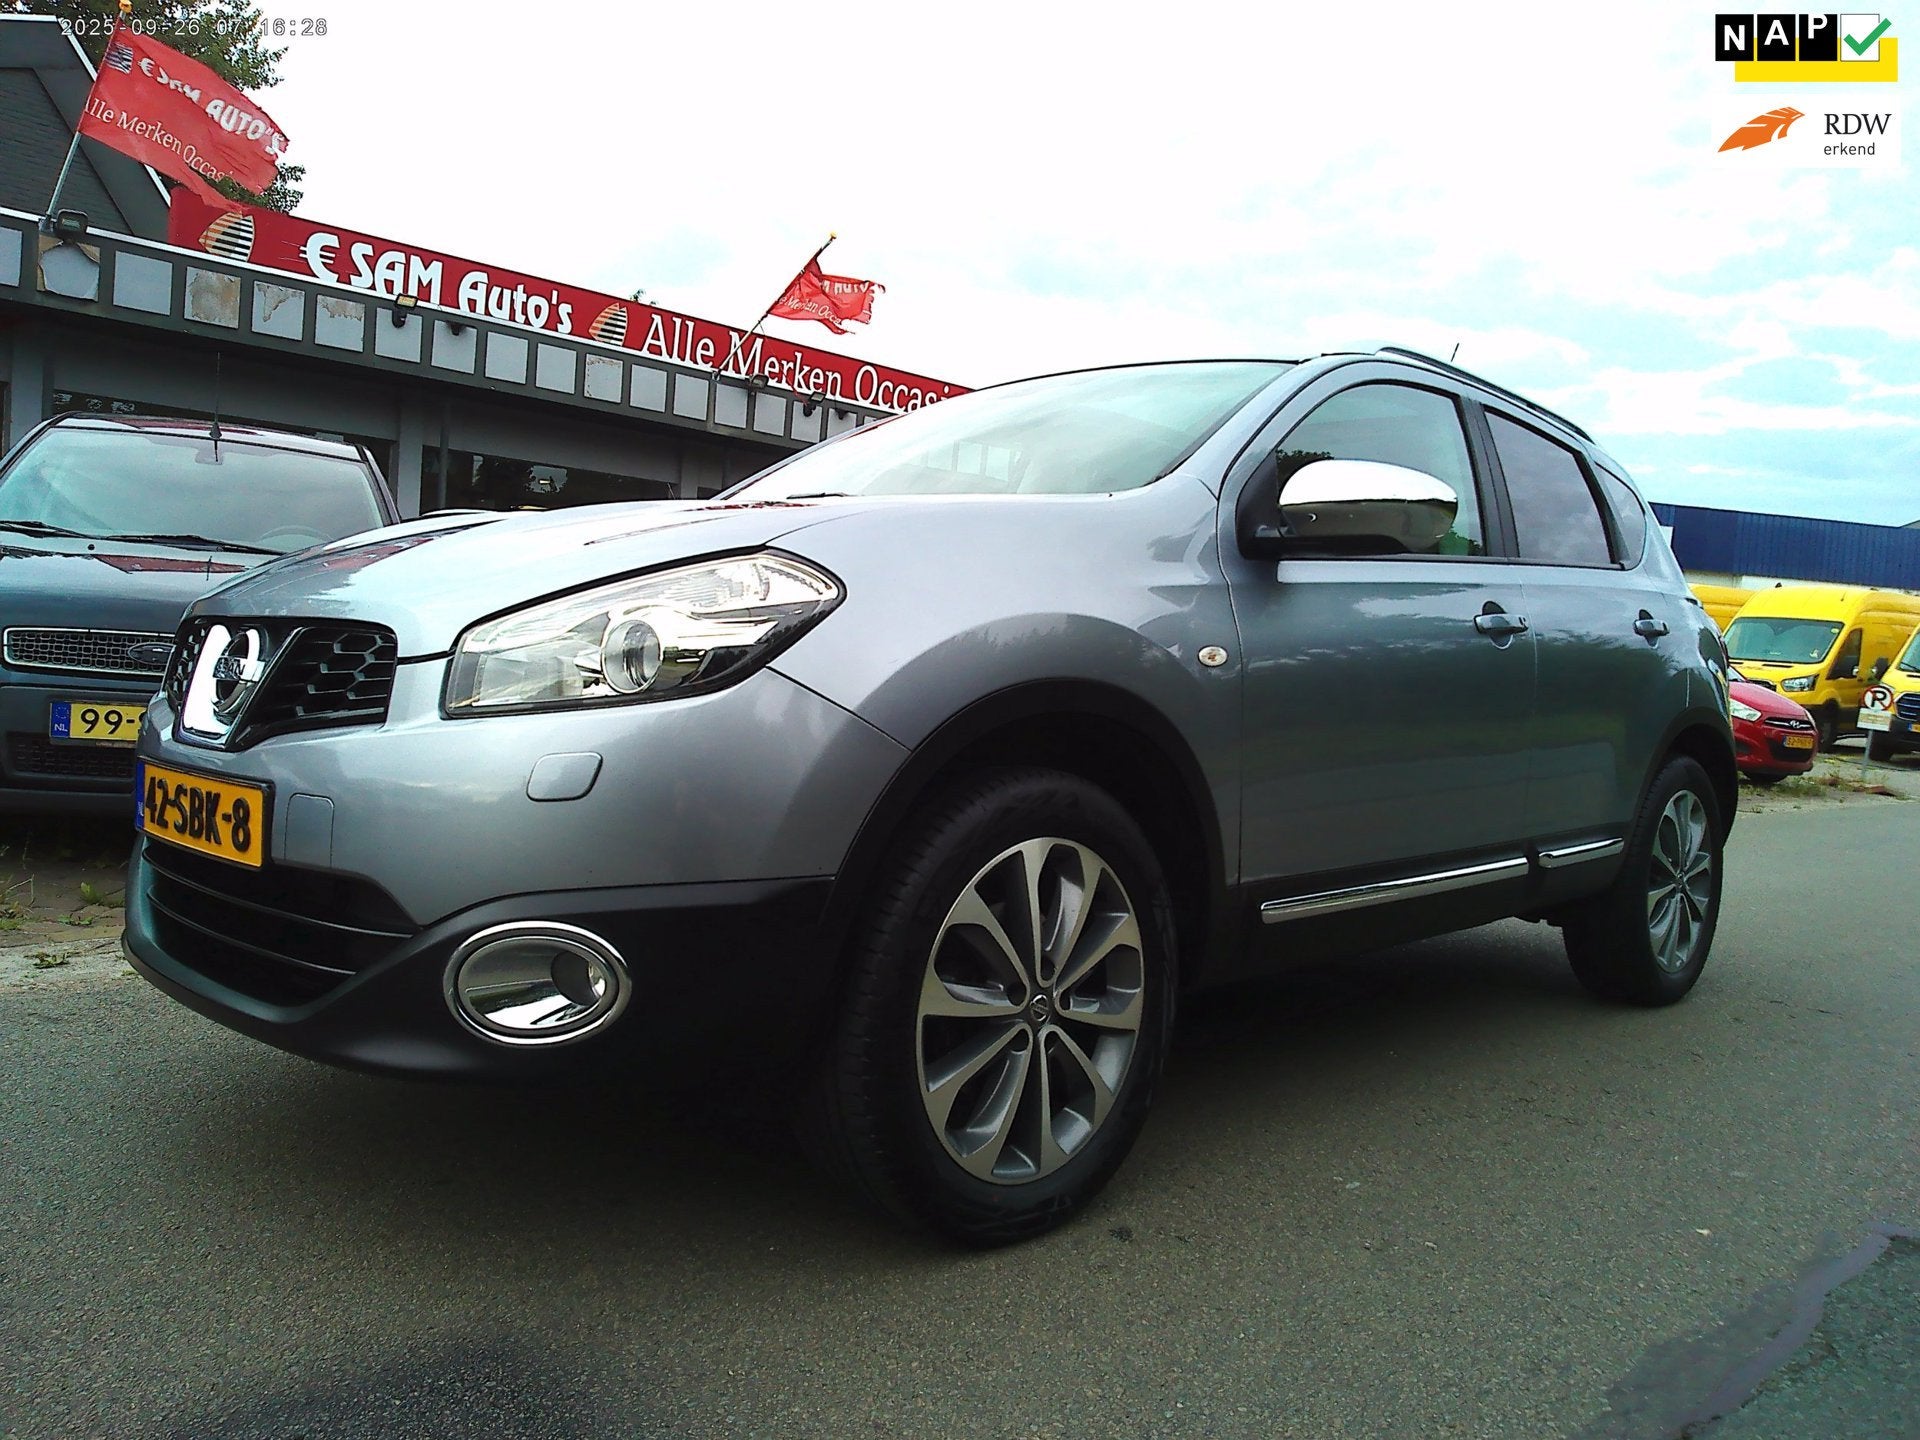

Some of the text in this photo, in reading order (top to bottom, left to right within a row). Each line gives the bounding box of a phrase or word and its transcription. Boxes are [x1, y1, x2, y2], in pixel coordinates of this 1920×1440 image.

[117, 111, 182, 155] Merken
[183, 145, 234, 182] Occas
[458, 271, 573, 335] Auto's
[643, 314, 715, 368] Alle
[722, 331, 841, 400] Merken
[855, 364, 950, 413] Occa
[54, 723, 68, 732] NL
